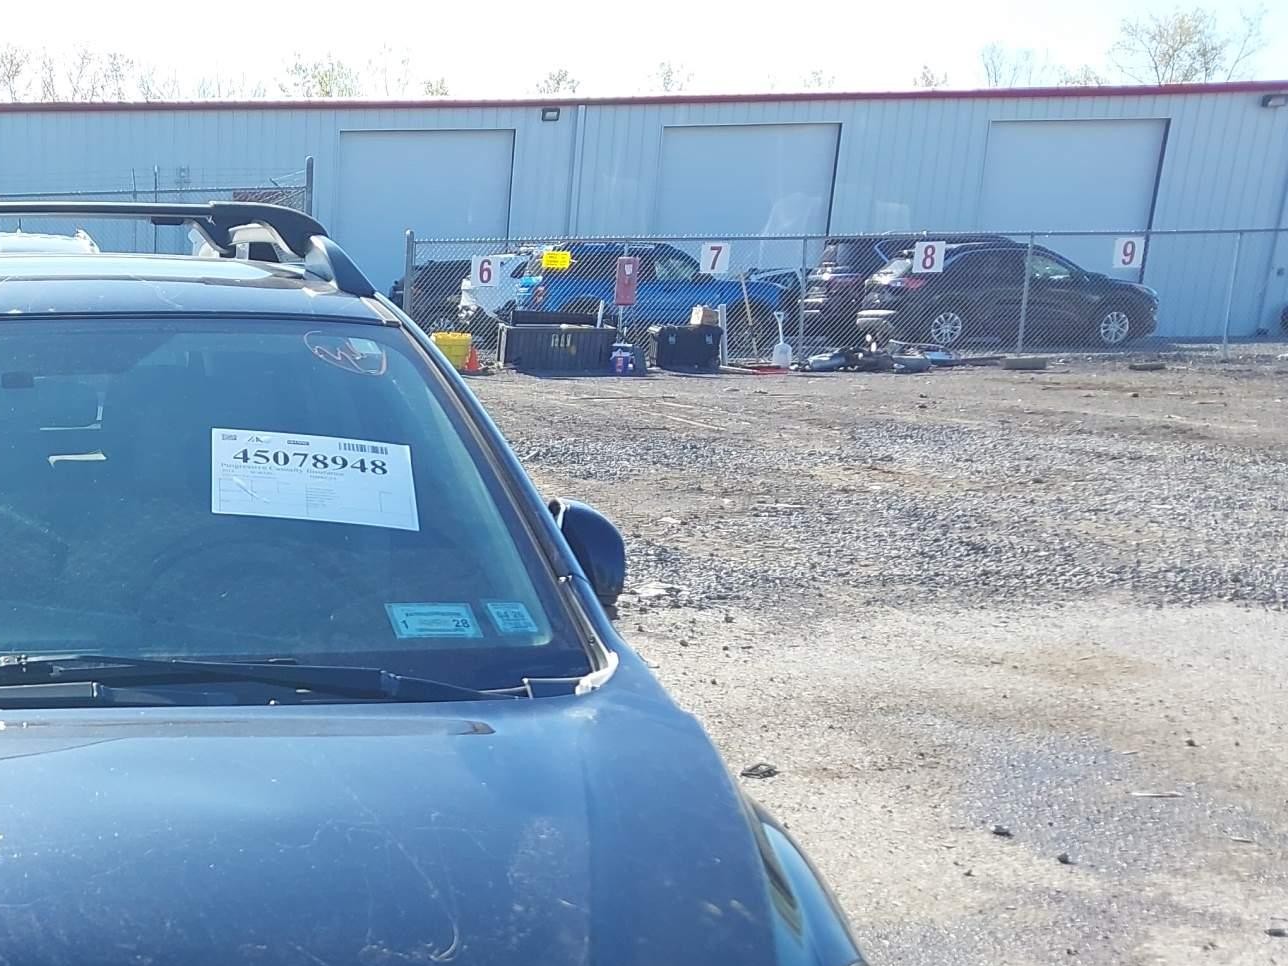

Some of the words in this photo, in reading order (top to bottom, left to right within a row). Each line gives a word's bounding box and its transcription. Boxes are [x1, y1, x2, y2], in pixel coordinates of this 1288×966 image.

[710, 245, 723, 270] 7
[922, 244, 936, 270] 8
[1122, 240, 1136, 266] 9
[479, 258, 492, 284] 6
[232, 447, 389, 476] 45078948
[452, 618, 471, 629] 28
